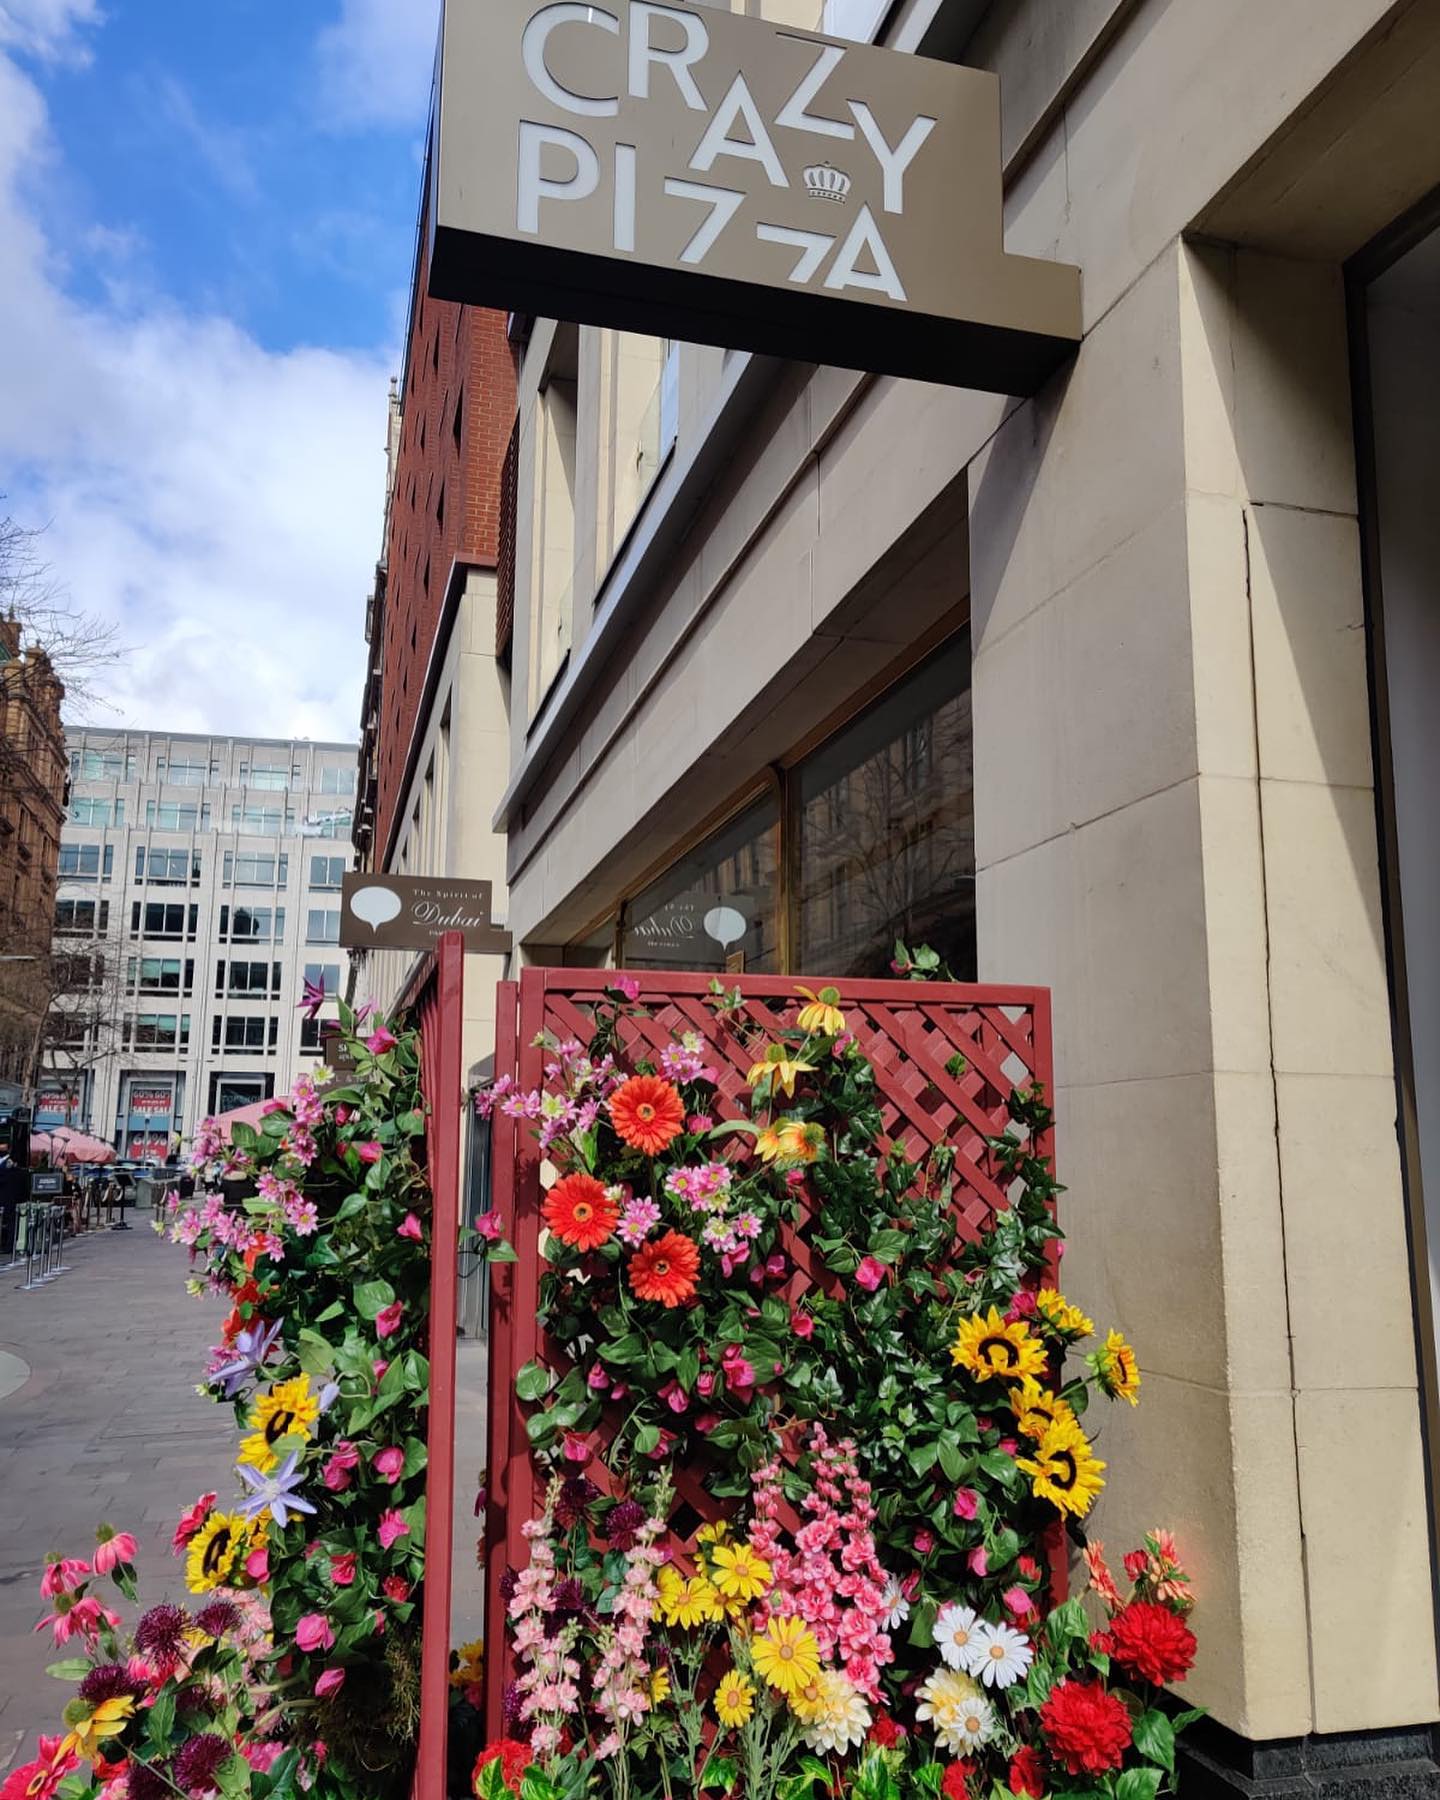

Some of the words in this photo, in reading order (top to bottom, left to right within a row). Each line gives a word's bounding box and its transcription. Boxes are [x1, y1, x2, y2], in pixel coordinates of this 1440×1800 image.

[521, 0, 937, 215] CRAZY
[516, 119, 907, 302] PIZZA
[411, 901, 484, 927] Dubai
[412, 889, 431, 897] The
[436, 890, 469, 899] Spirit
